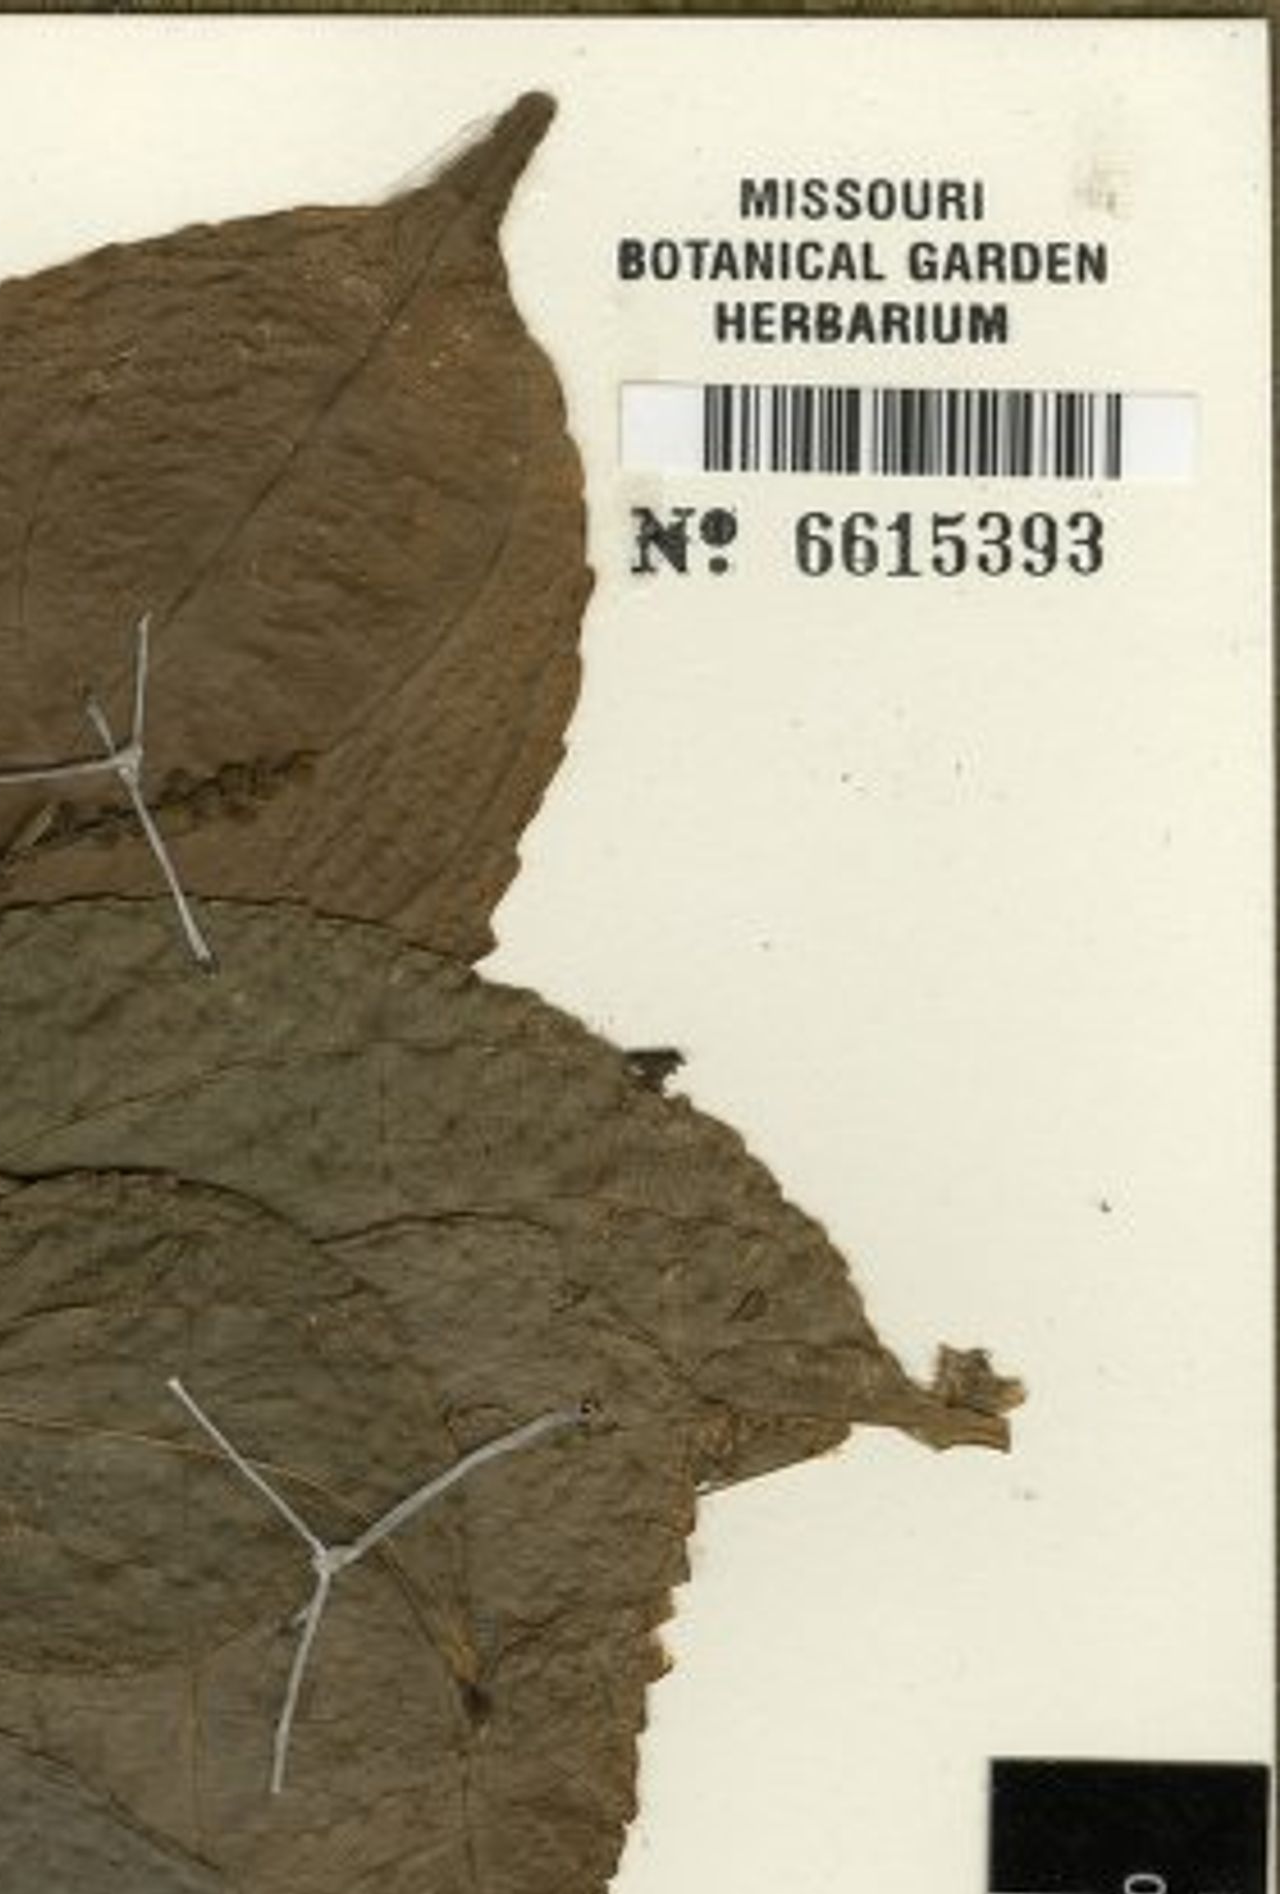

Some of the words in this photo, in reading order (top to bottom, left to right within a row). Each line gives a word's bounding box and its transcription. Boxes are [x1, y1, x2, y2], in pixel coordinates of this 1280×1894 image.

[739, 177, 984, 222] MISSOURI
[617, 238, 887, 282] BOTANICAL
[907, 241, 1108, 284] GARDEN
[714, 301, 1009, 345] HERBARIUM
[795, 511, 1104, 578] 6615393
